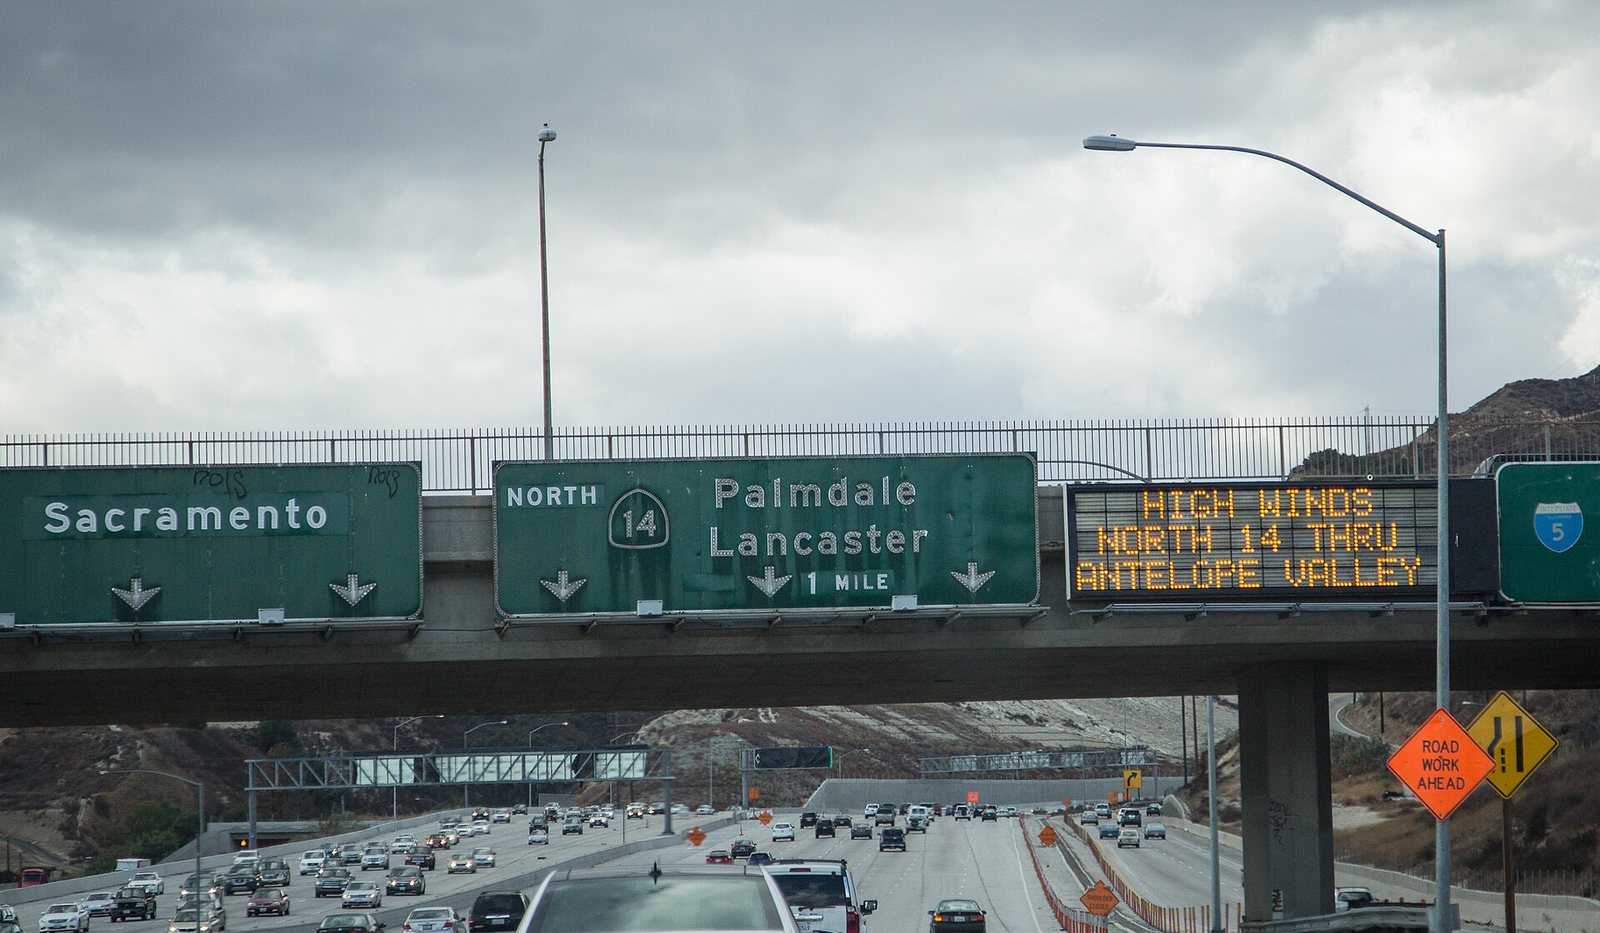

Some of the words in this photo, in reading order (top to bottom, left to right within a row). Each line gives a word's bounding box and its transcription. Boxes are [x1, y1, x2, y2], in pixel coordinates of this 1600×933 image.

[507, 485, 597, 507] NORTH
[714, 476, 916, 509] Palmdale
[1143, 488, 1234, 520] HIGH
[1259, 487, 1373, 519] WINDS
[44, 498, 327, 533] Sacramento
[1539, 505, 1577, 513] INTERSTATE
[622, 509, 658, 538] 14
[1552, 522, 1565, 542] 5
[709, 525, 928, 558] Lancaster
[1097, 524, 1213, 556] NORTH
[1240, 523, 1281, 553] 14
[1305, 522, 1397, 552] THRU
[807, 572, 817, 595] 1
[835, 573, 889, 591] MILE
[1076, 559, 1261, 591] ANTELOPE
[1284, 555, 1421, 587] VALLEY
[1422, 739, 1459, 753] ROAD
[1422, 757, 1459, 771] WORK
[1417, 776, 1466, 790] AHEAD
